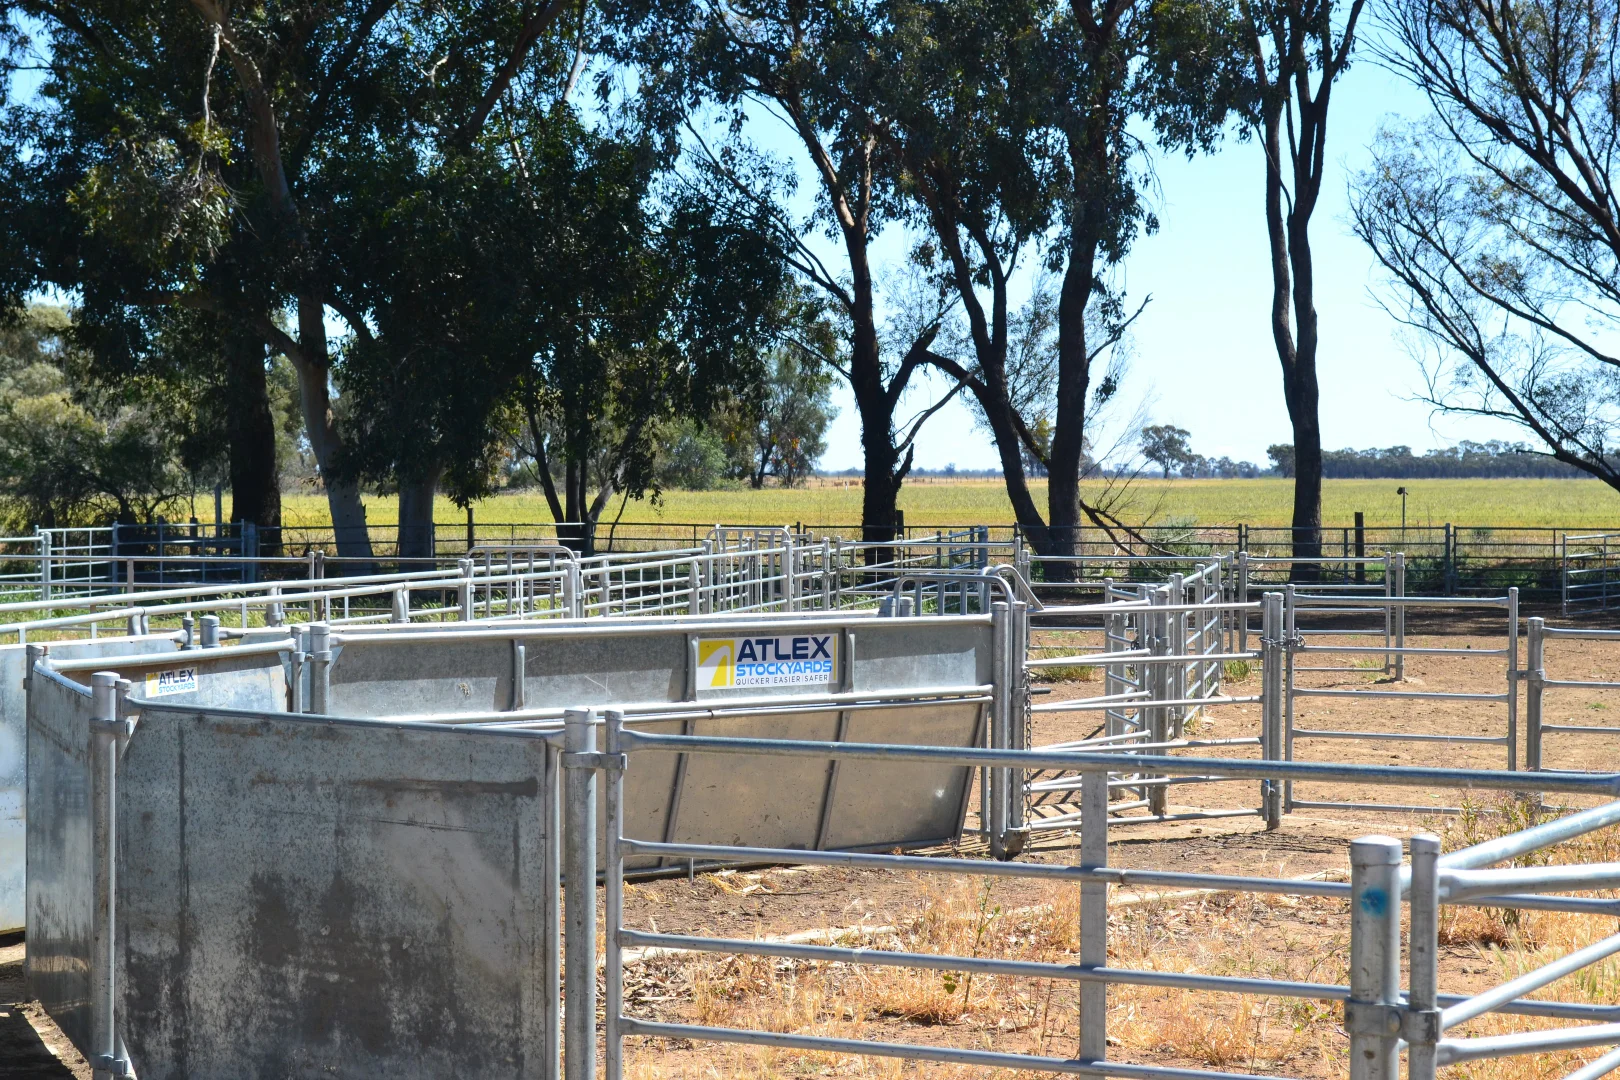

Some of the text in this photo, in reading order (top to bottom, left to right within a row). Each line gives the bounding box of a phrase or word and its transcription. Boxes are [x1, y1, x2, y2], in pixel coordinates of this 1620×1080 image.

[737, 636, 831, 662] ATLEX
[736, 660, 832, 676] STOCKYARDS
[159, 669, 194, 685] ATLEX
[736, 674, 828, 686] QUICKER EASIER SAFER
[159, 682, 195, 694] STOCKYARDS
